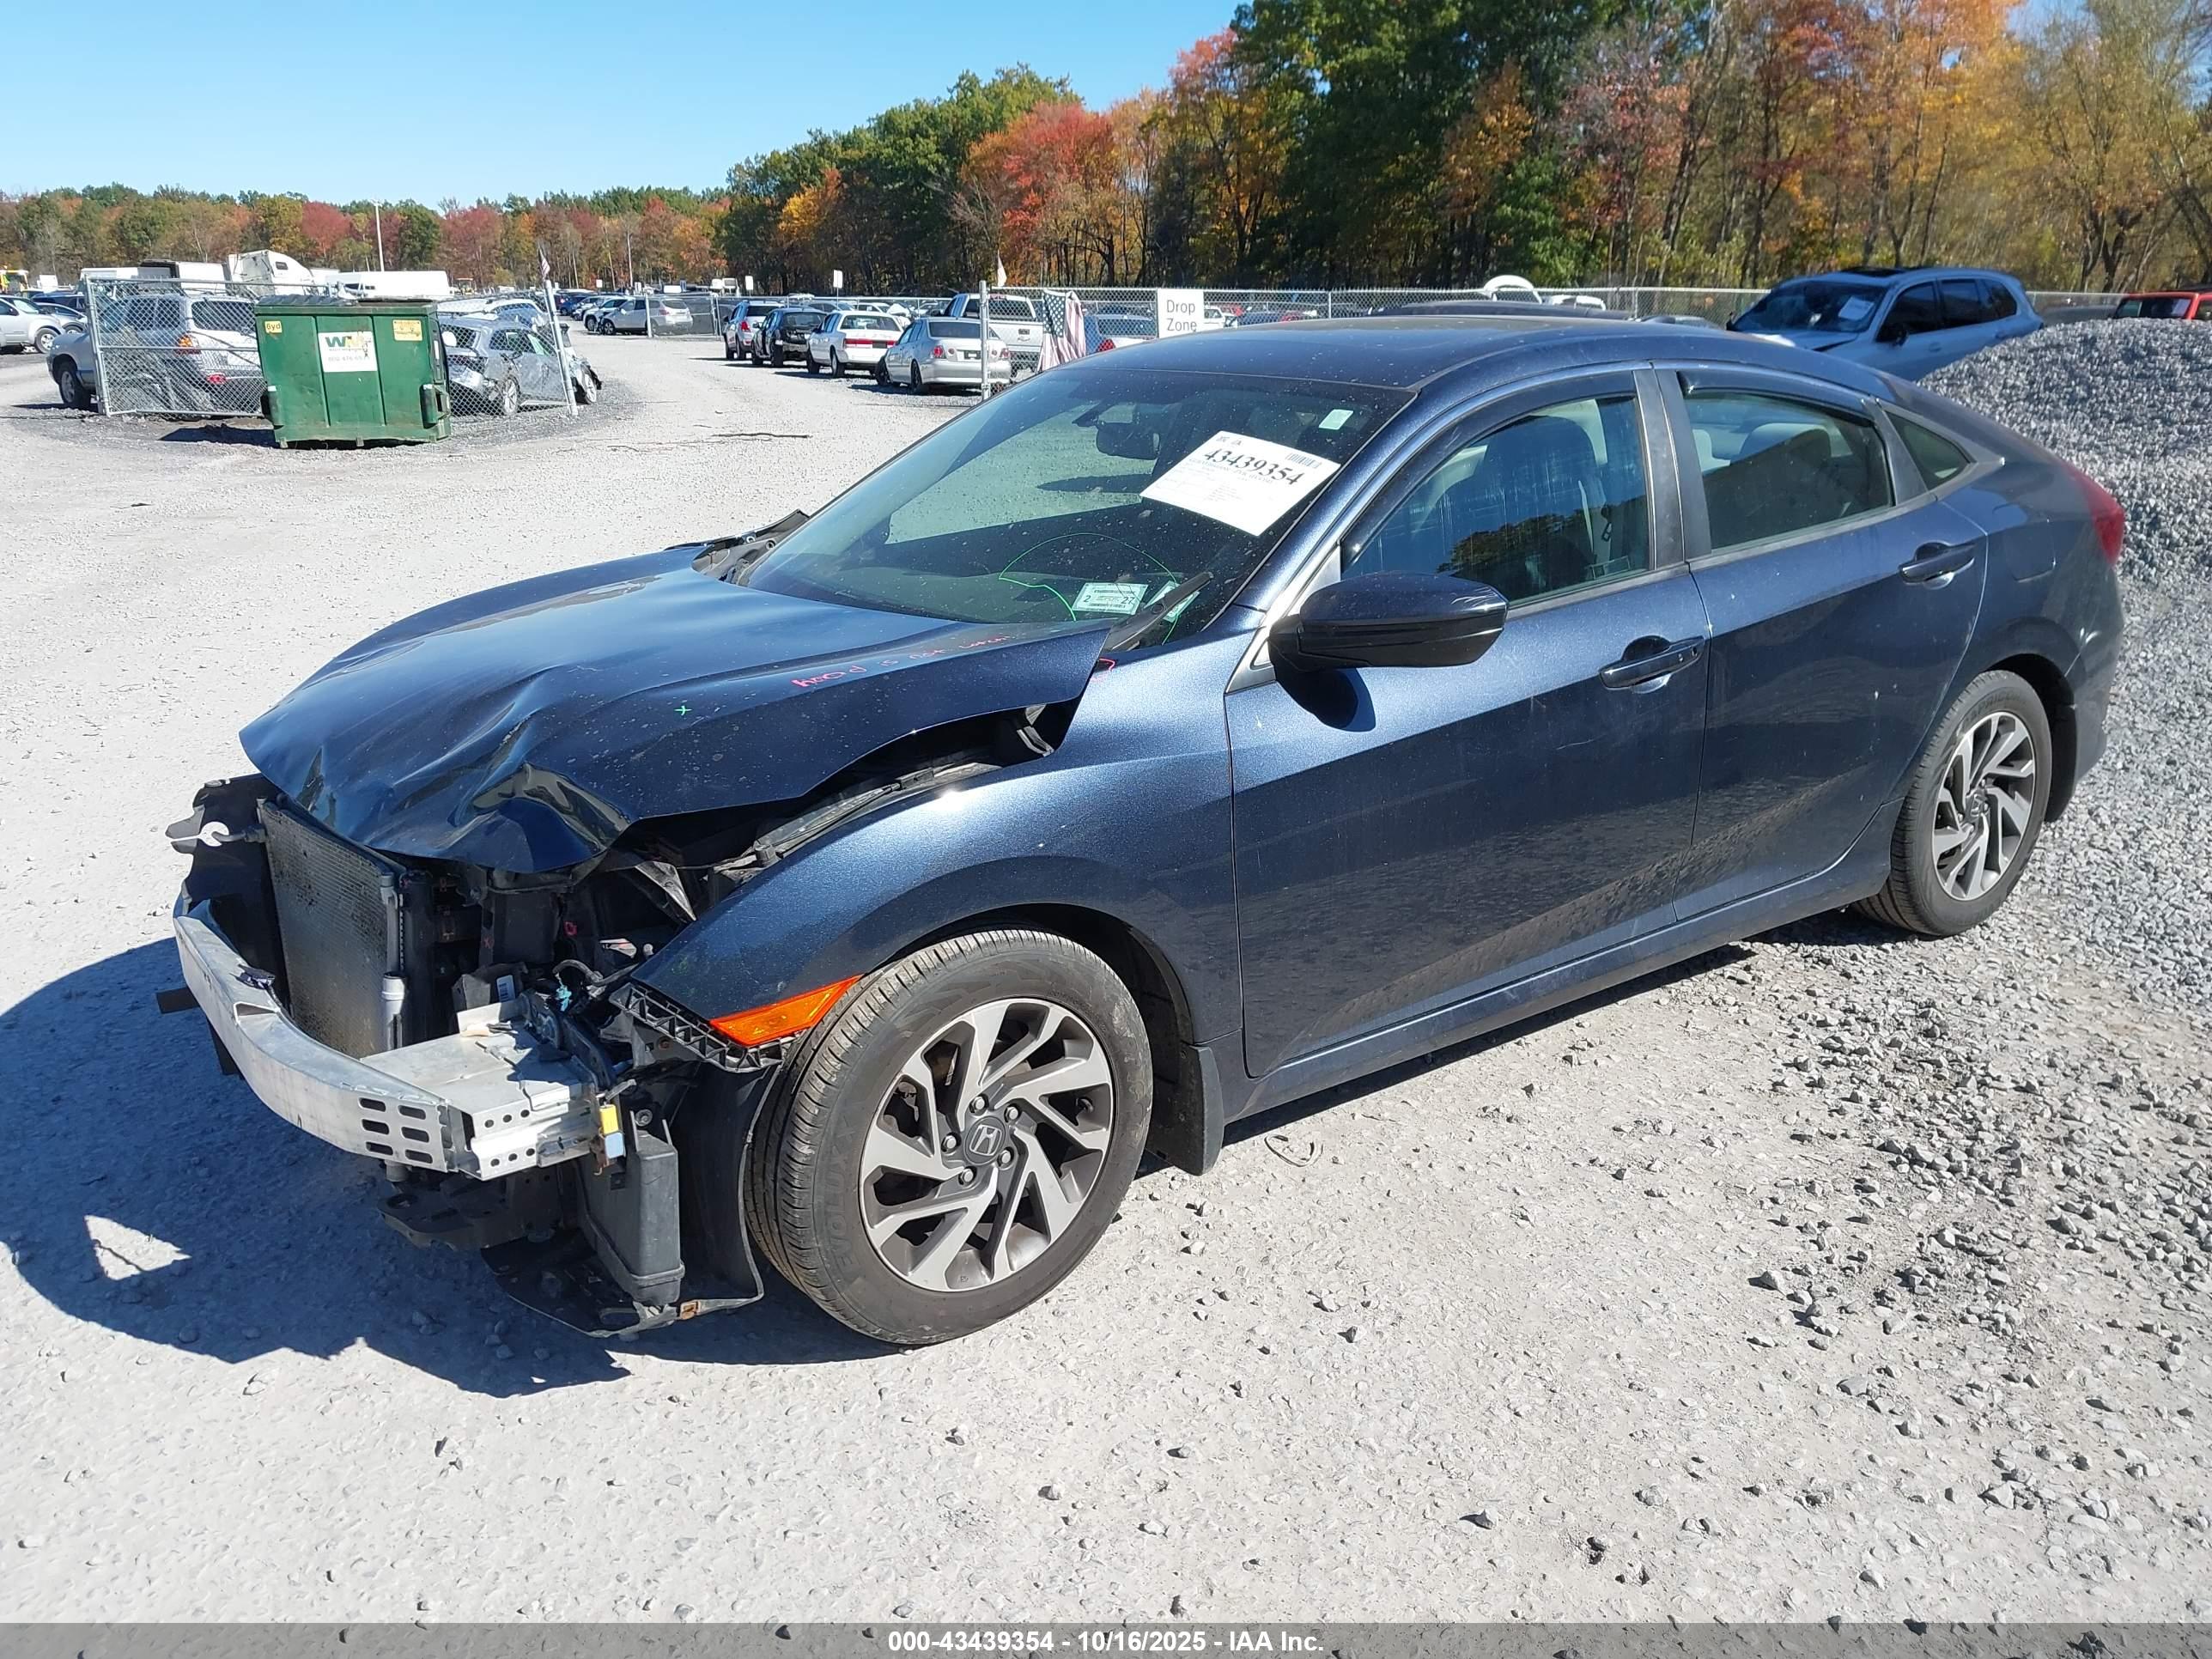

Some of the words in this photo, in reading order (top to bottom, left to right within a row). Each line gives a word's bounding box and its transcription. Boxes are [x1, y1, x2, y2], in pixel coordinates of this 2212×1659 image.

[1167, 300, 1195, 315] Drop
[1167, 318, 1197, 331] Zone
[1204, 448, 1304, 485] 43439354
